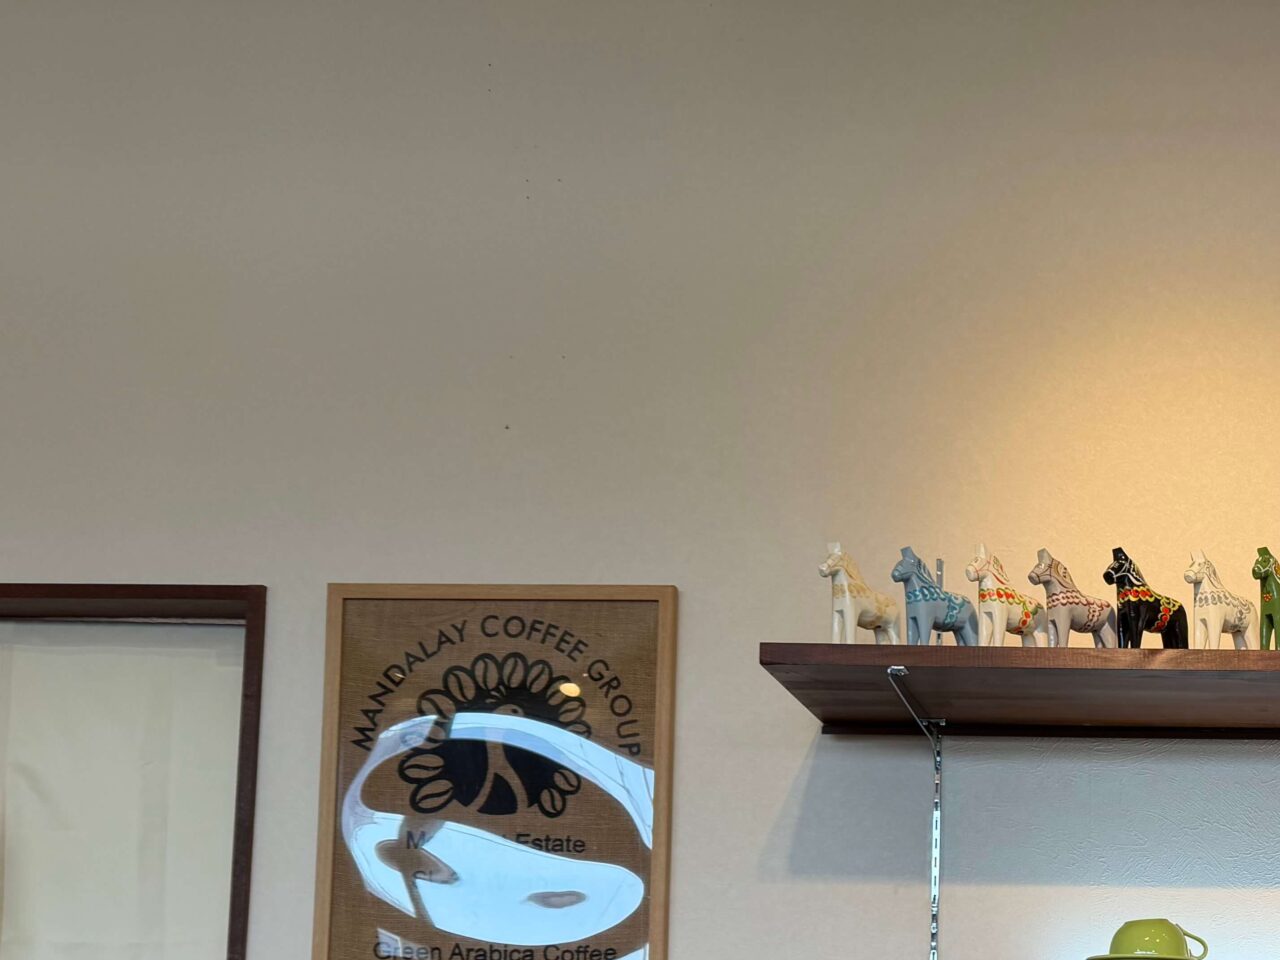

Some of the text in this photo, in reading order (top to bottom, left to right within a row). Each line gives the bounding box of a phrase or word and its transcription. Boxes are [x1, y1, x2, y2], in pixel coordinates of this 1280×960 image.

[351, 614, 641, 757] MANDALAY COFFEE GROUP
[373, 941, 442, 960] Green
